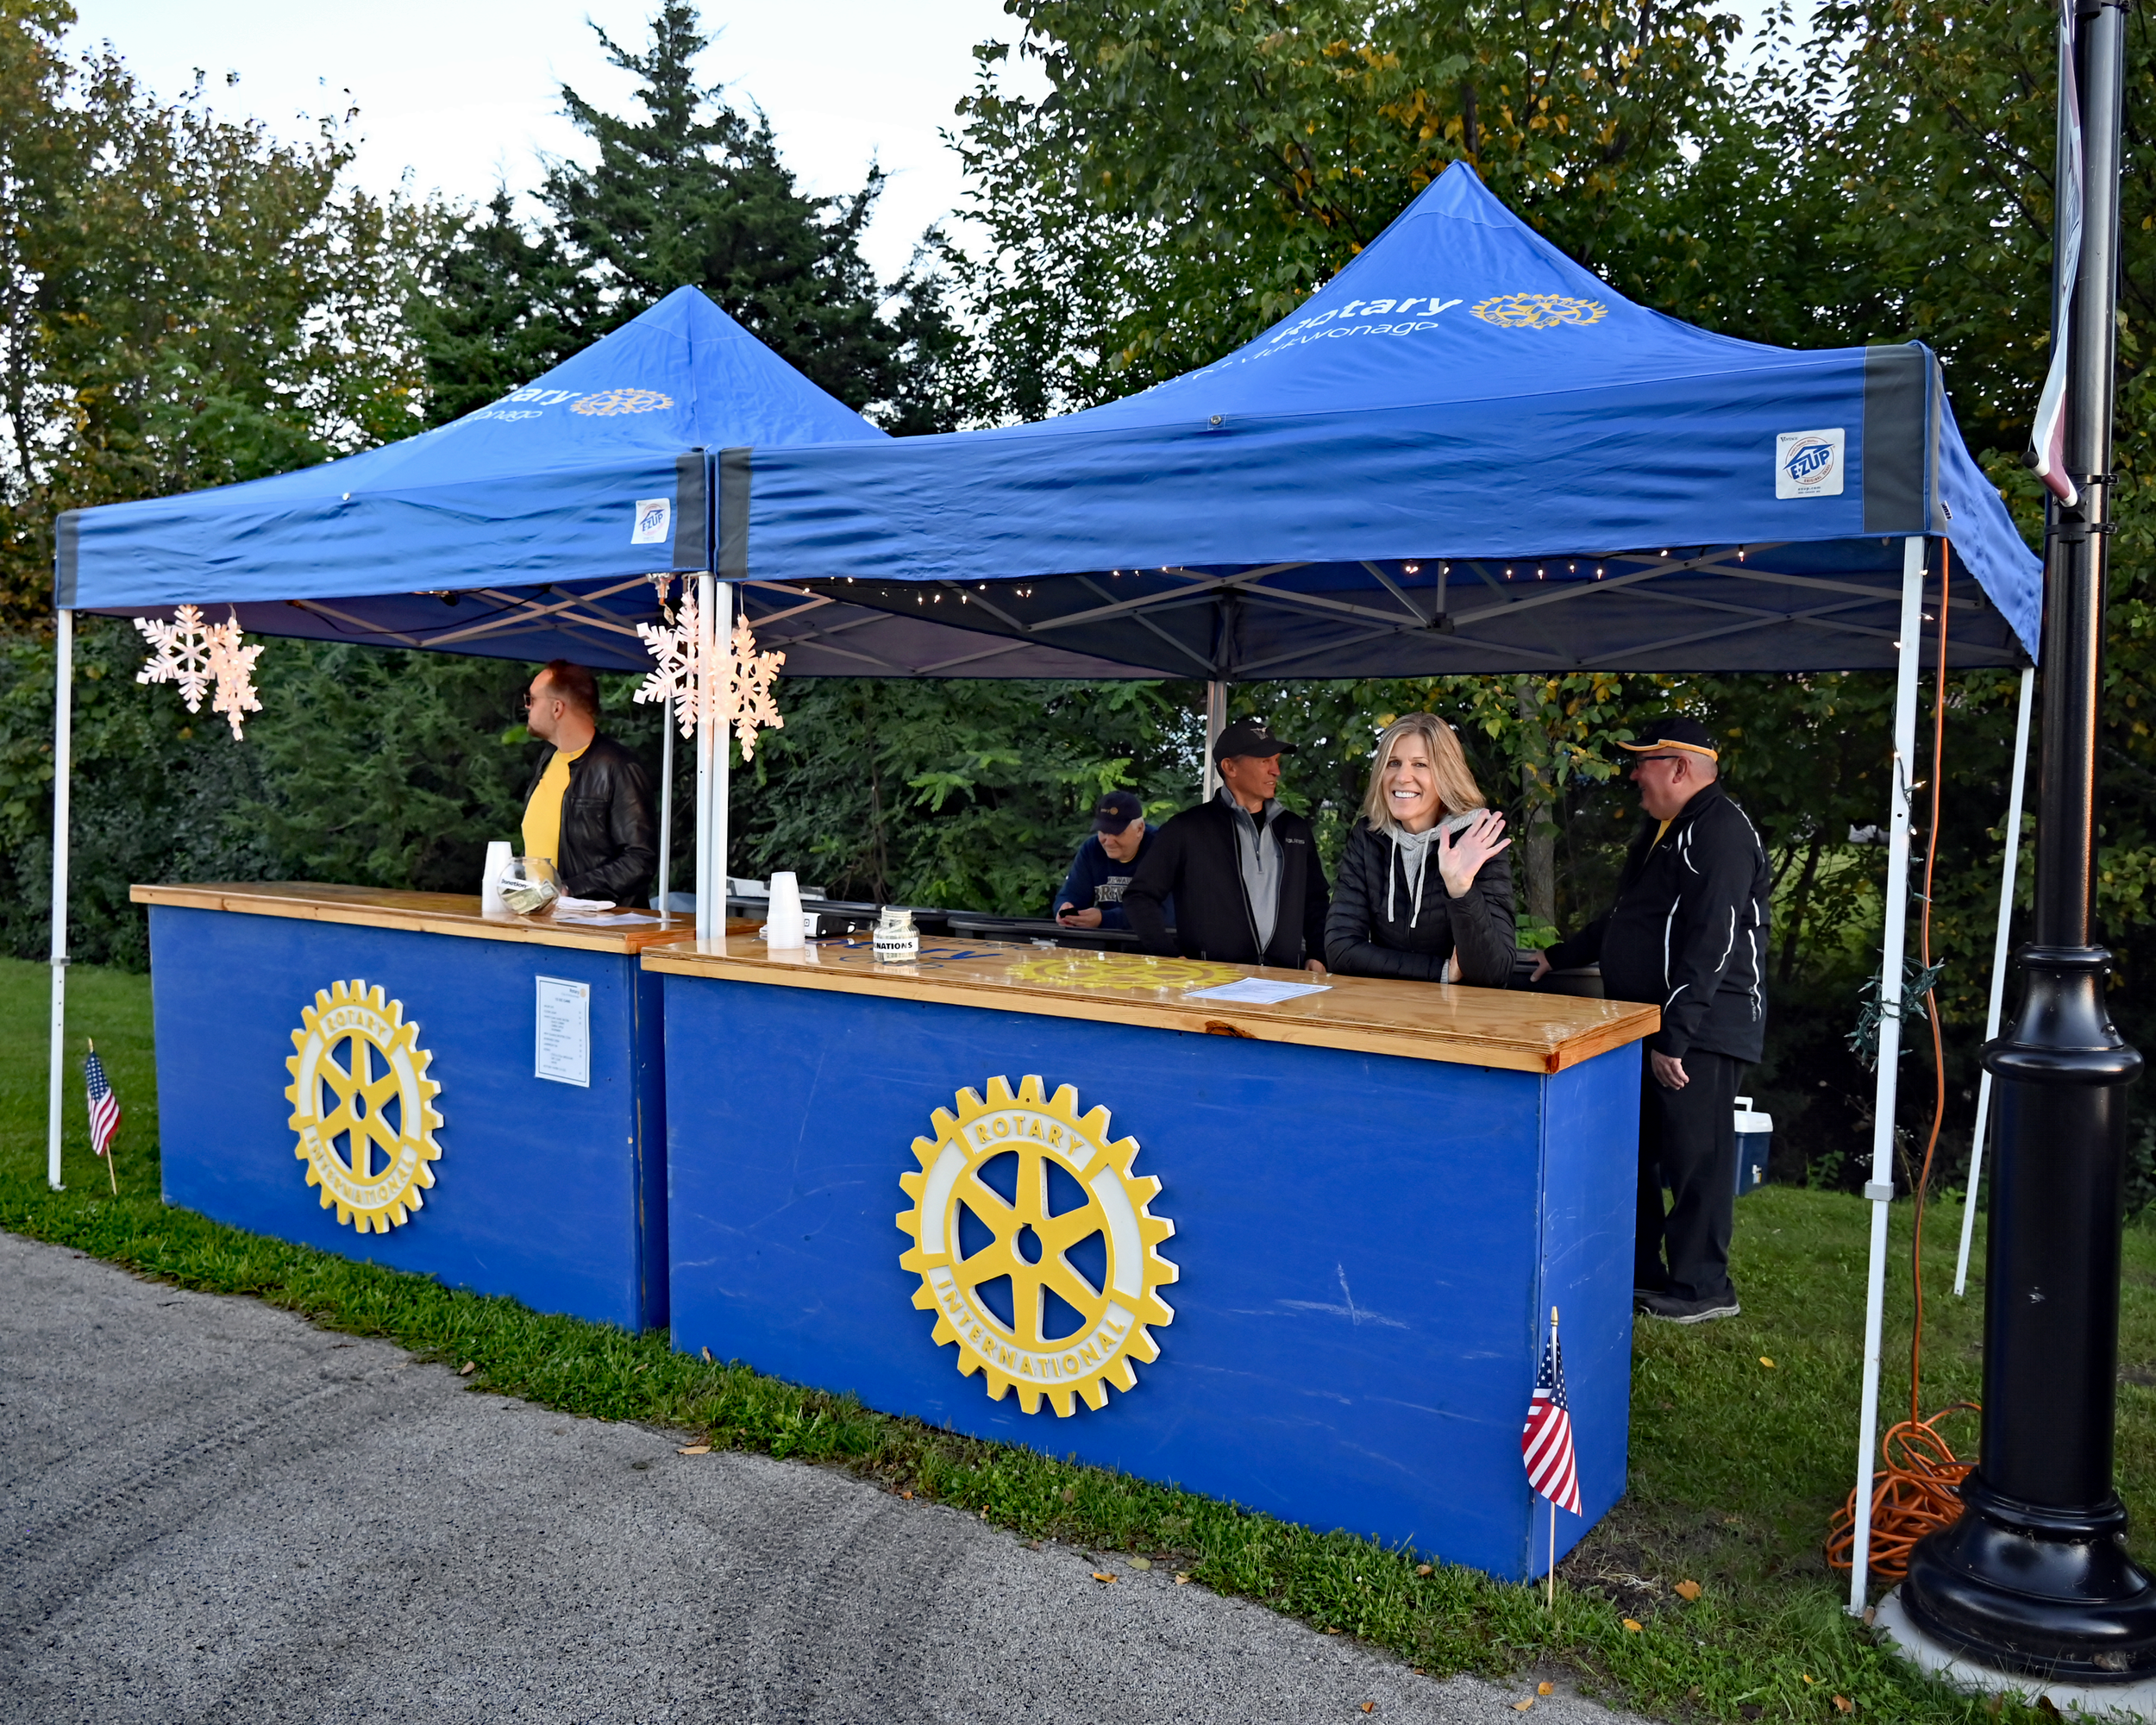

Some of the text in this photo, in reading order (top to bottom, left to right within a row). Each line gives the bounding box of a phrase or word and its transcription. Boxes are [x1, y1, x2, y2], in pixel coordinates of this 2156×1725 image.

[874, 941, 913, 950] NATIONS
[326, 1010, 386, 1037] ROTARY
[975, 1115, 1085, 1157] ROTARY
[308, 1134, 414, 1205] INTERNATIONAL
[937, 1278, 1126, 1378] INTERNATIONAL
